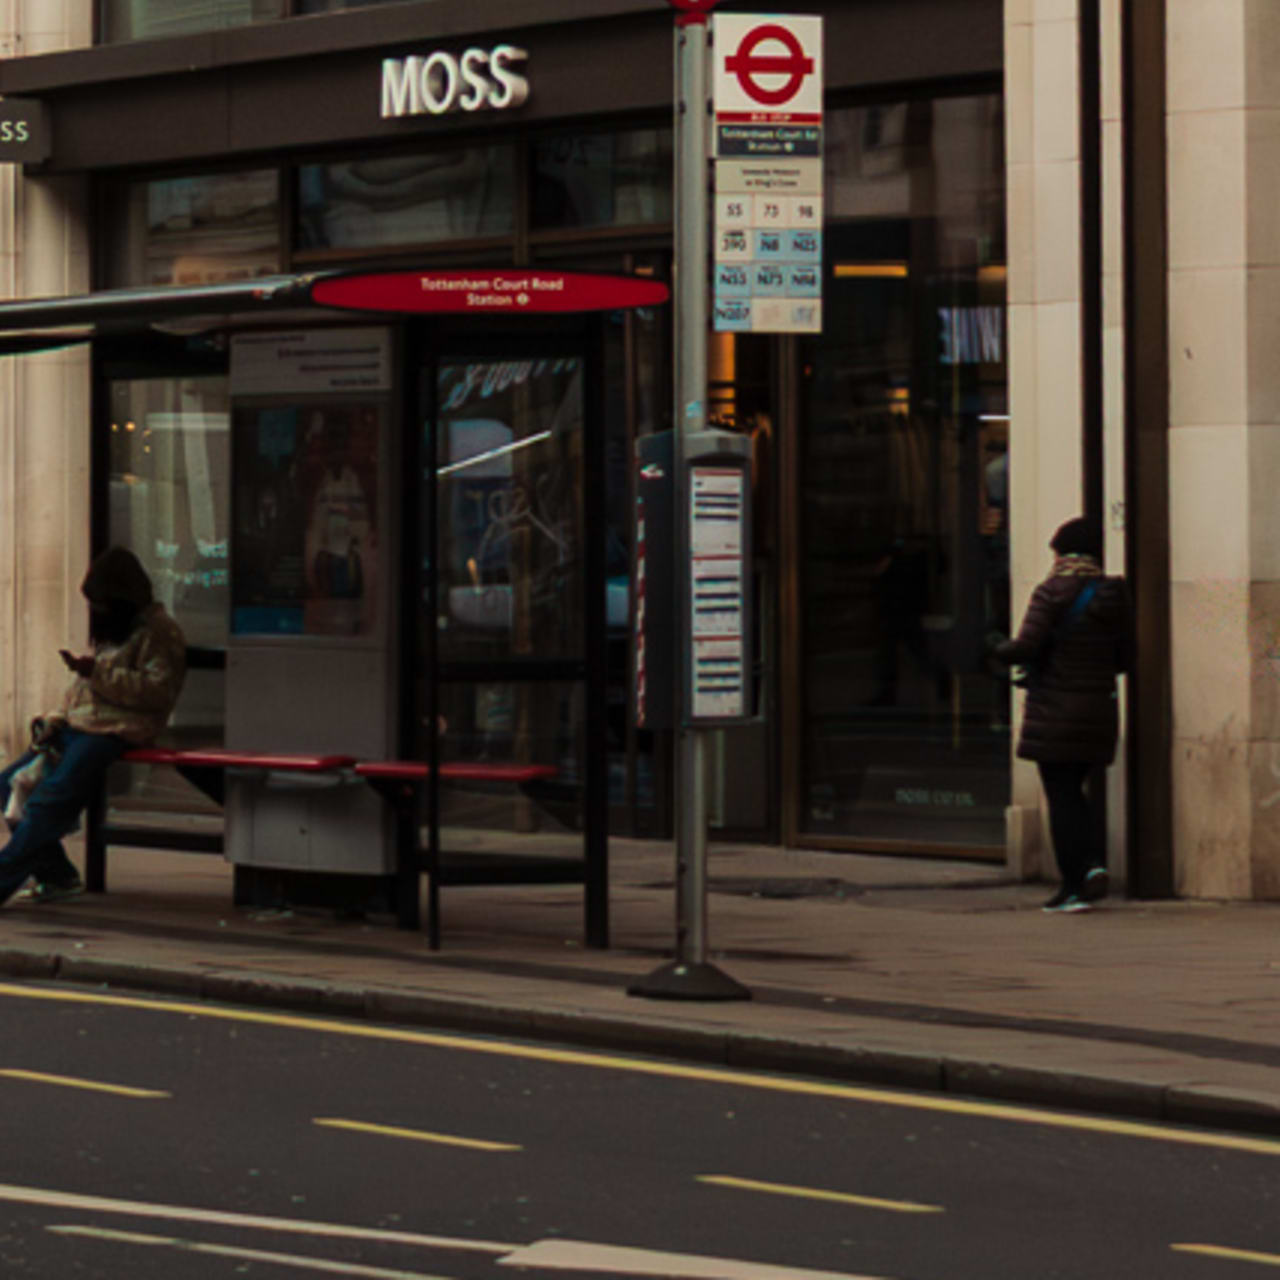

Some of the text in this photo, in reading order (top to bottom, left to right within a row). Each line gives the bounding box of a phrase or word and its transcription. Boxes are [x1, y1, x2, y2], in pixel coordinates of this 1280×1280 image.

[381, 44, 528, 118] MOSS
[421, 278, 564, 291] Tottenham Court Road
[466, 293, 513, 306] Station
